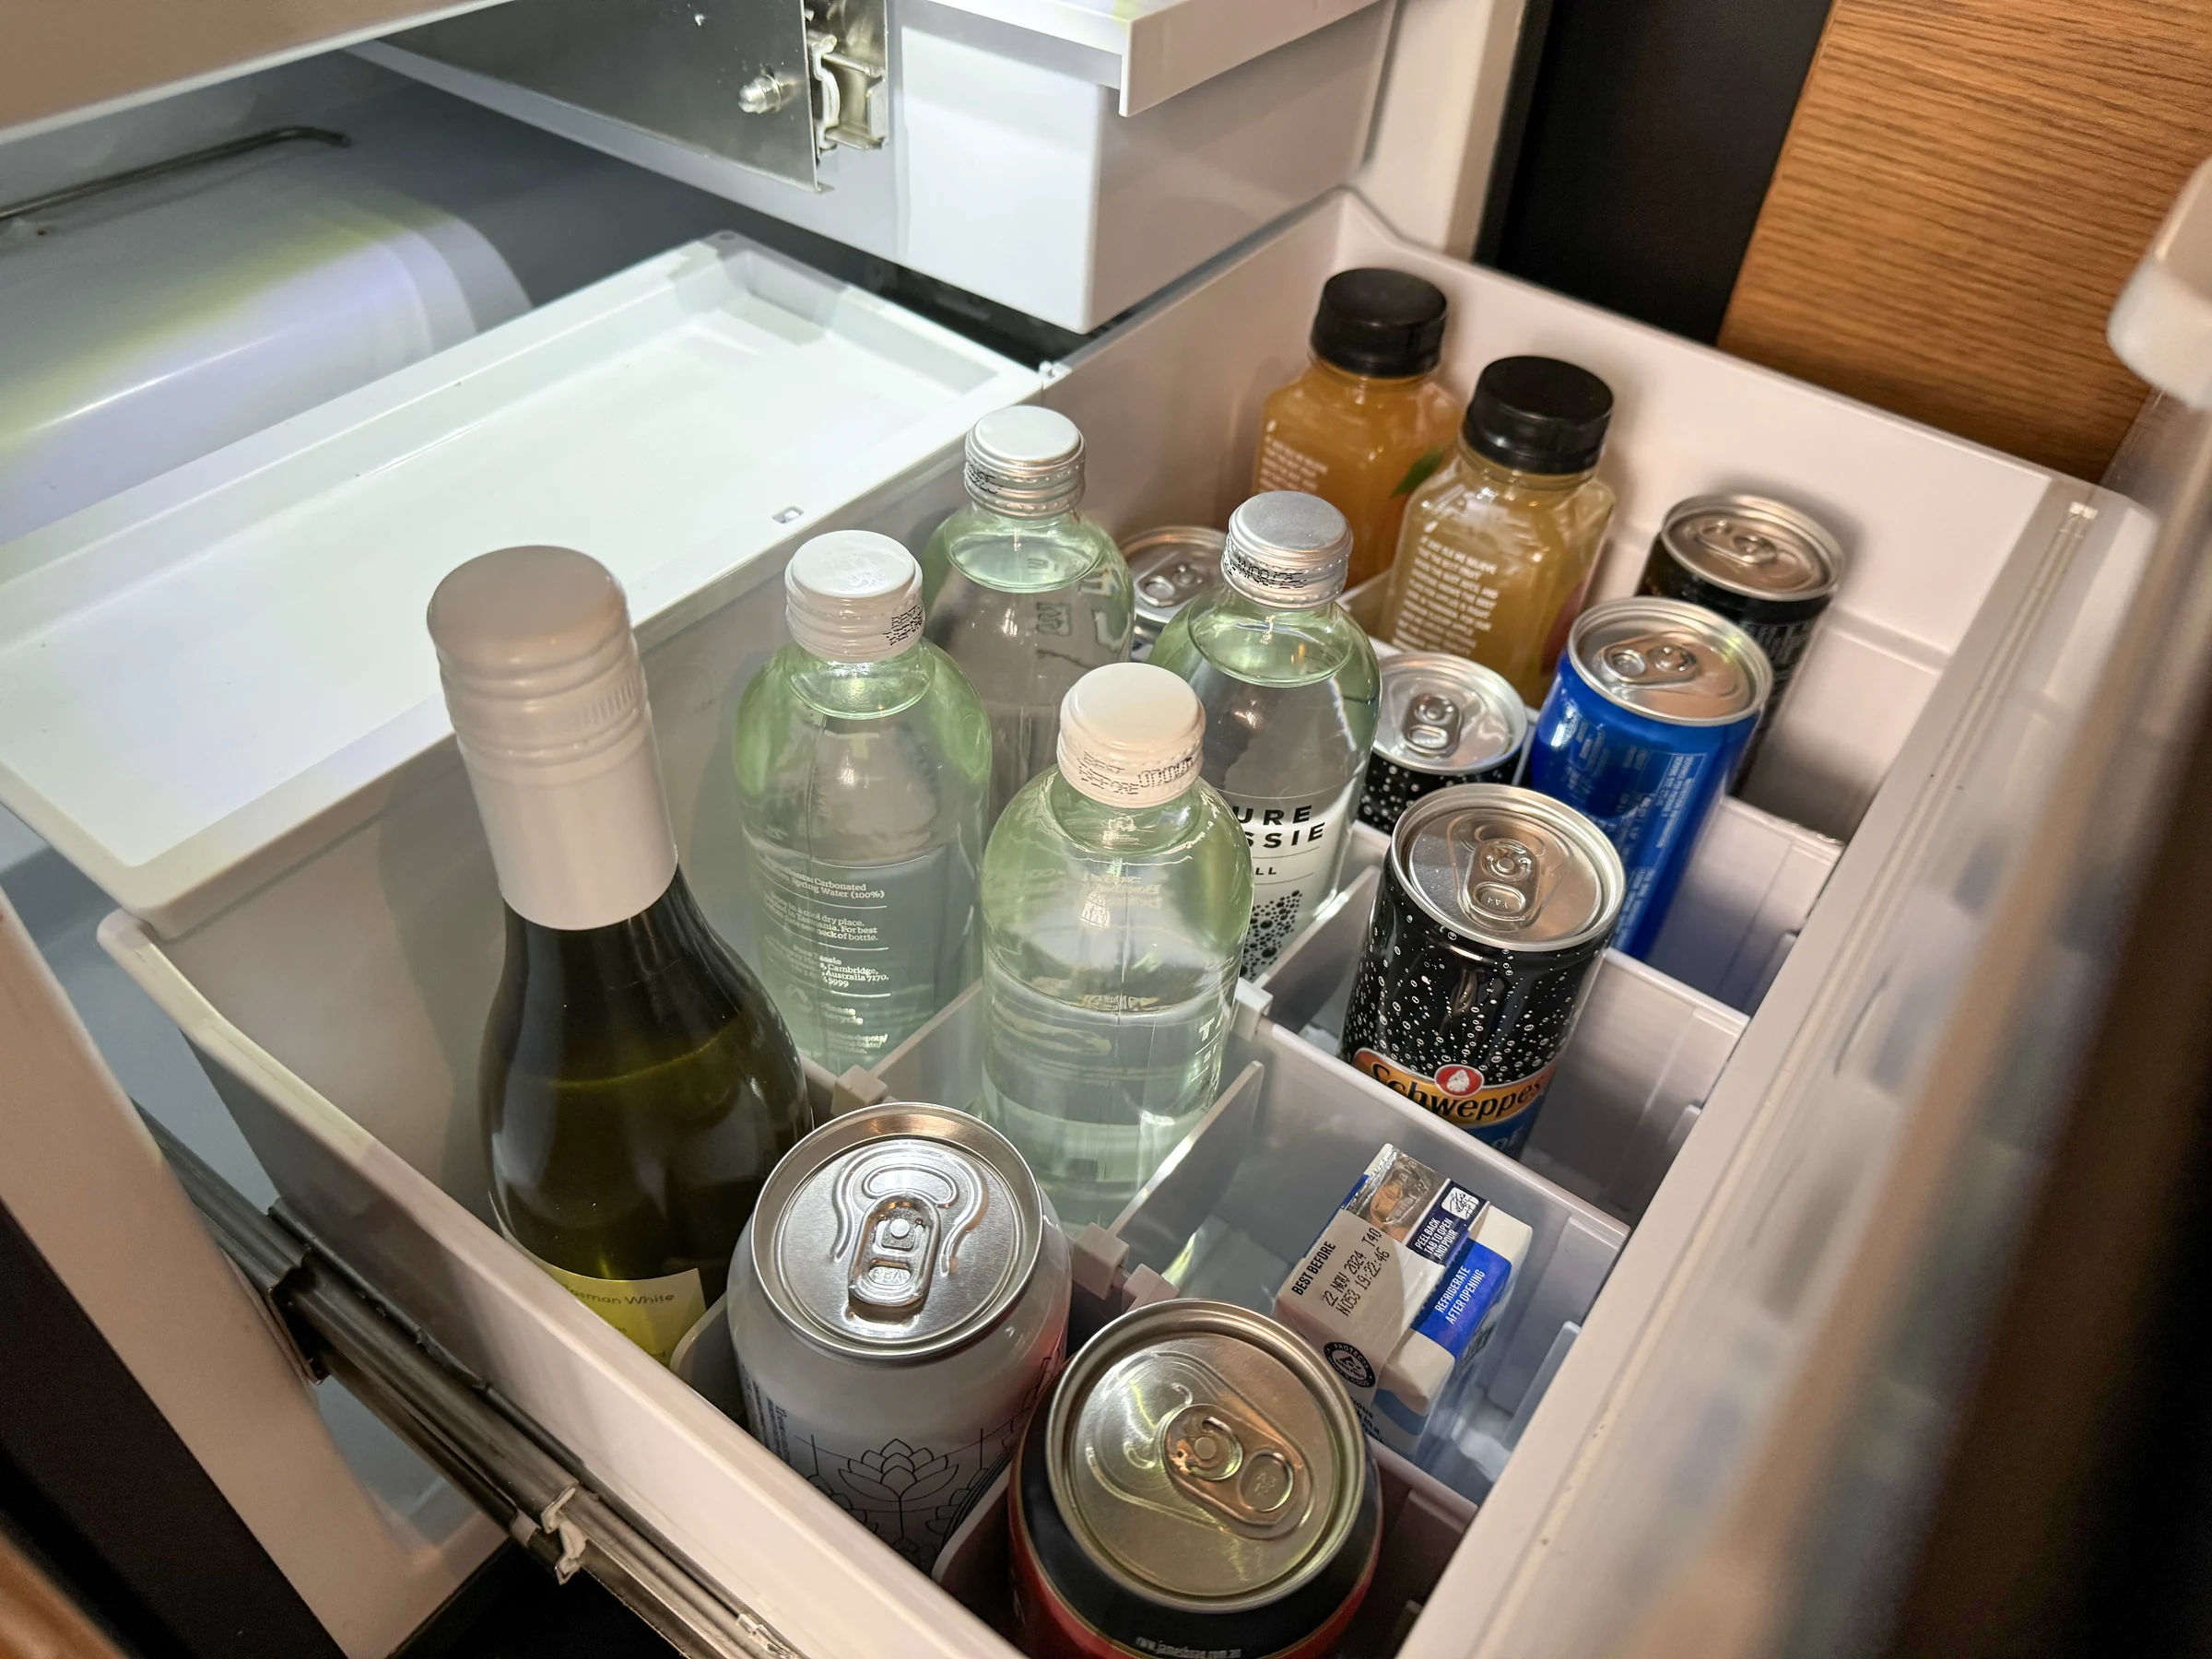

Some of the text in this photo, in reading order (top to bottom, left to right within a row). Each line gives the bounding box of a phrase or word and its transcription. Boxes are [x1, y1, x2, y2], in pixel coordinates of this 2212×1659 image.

[1232, 805, 1312, 826] URE
[1244, 821, 1325, 848] SSIE
[792, 877, 885, 900] Spring Water (100%)
[815, 877, 866, 891] Carbonated
[796, 913, 840, 932] Tasmania.
[841, 925, 856, 934] For
[857, 926, 878, 935] best
[803, 909, 821, 921] cool
[821, 915, 837, 925] dry
[838, 918, 865, 928] place.
[816, 929, 838, 939] neck
[838, 932, 848, 940] of
[849, 932, 878, 941] bottle.
[826, 971, 866, 982] Australia
[866, 974, 889, 983] 7170.
[828, 963, 878, 976] Cambridge,
[1414, 1217, 1441, 1250] PEEL BACK
[1423, 1217, 1453, 1254] TAB TO OPEN
[1432, 1228, 1457, 1259] AND POUR
[1291, 1241, 1335, 1296] BEST BEFORE
[1321, 1290, 1338, 1307] 22
[1344, 1250, 1367, 1275] 2024
[1361, 1227, 1382, 1247] T40
[1354, 1246, 1390, 1290] 19:22:46
[627, 1293, 675, 1305] White
[1434, 1265, 1470, 1313] REFRIGERATE
[1444, 1298, 1466, 1324] AFTER
[1458, 1268, 1485, 1301] OPENING
